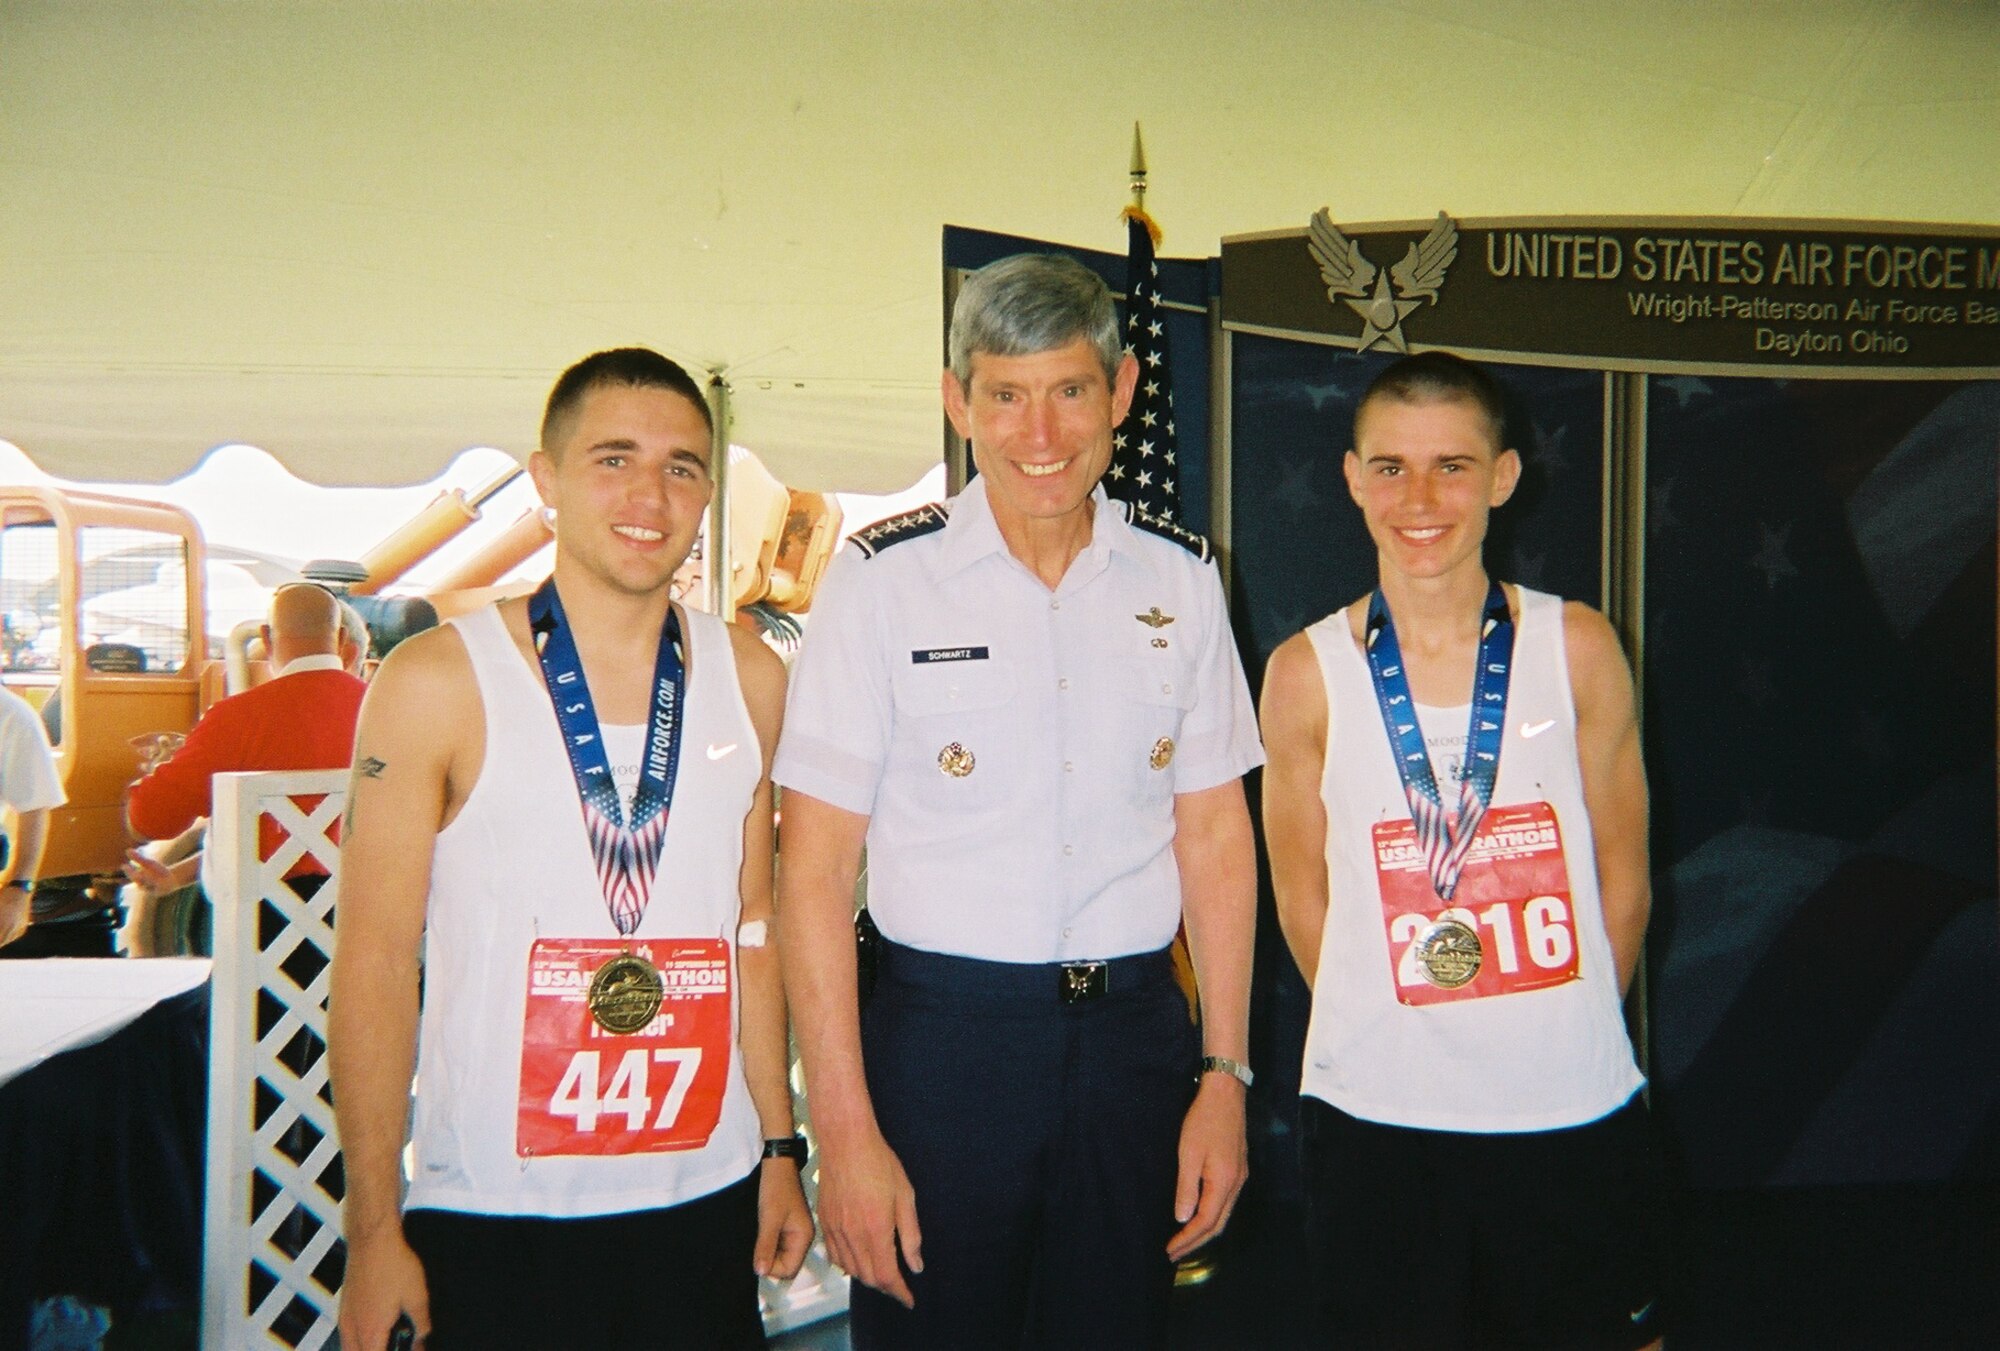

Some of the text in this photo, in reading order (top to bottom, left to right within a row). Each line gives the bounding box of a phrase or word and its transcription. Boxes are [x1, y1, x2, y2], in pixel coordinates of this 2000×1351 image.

[1487, 232, 1623, 280] UNITED
[1633, 236, 1765, 285] STATES
[1772, 242, 1834, 287] AIR
[1843, 244, 1968, 290] FORCE
[1628, 292, 1838, 323] Wright-Patterson
[1845, 299, 1881, 322] Air
[1888, 300, 1959, 324] Force
[1755, 327, 1909, 357] Dayton Ohio
[928, 649, 971, 660] SCHWARTZ
[648, 677, 675, 781] AIRFORCE.COM
[1378, 845, 1425, 863] USA
[549, 1047, 702, 1132] 447
